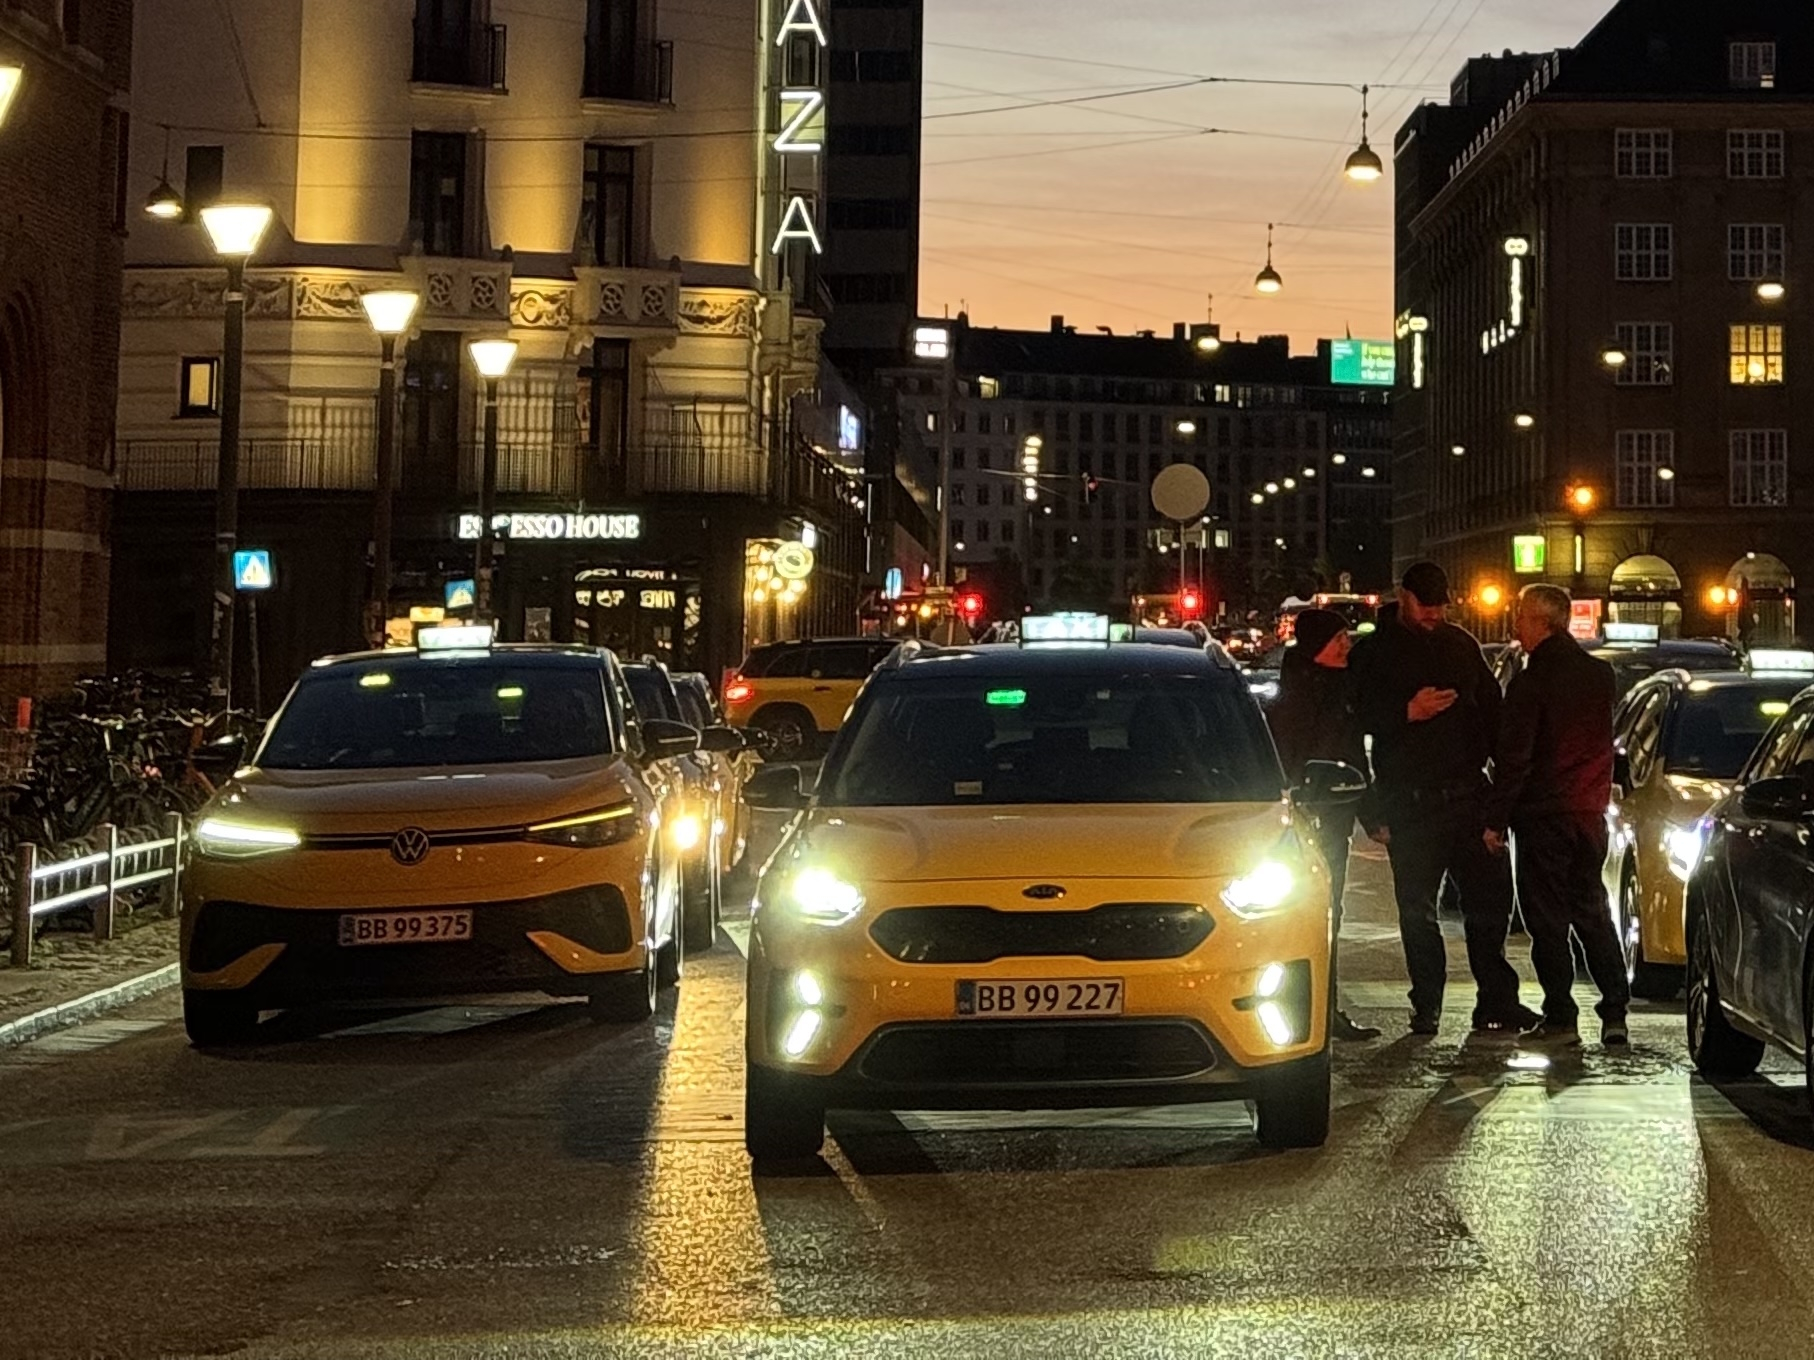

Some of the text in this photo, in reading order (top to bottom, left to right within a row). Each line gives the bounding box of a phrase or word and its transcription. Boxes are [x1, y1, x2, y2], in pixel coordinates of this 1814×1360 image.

[565, 514, 640, 539] HOUSE
[357, 914, 468, 939] BB 99 375
[978, 985, 1016, 1011] BB
[1024, 984, 1059, 1012] 99
[1066, 983, 1120, 1010] 227
